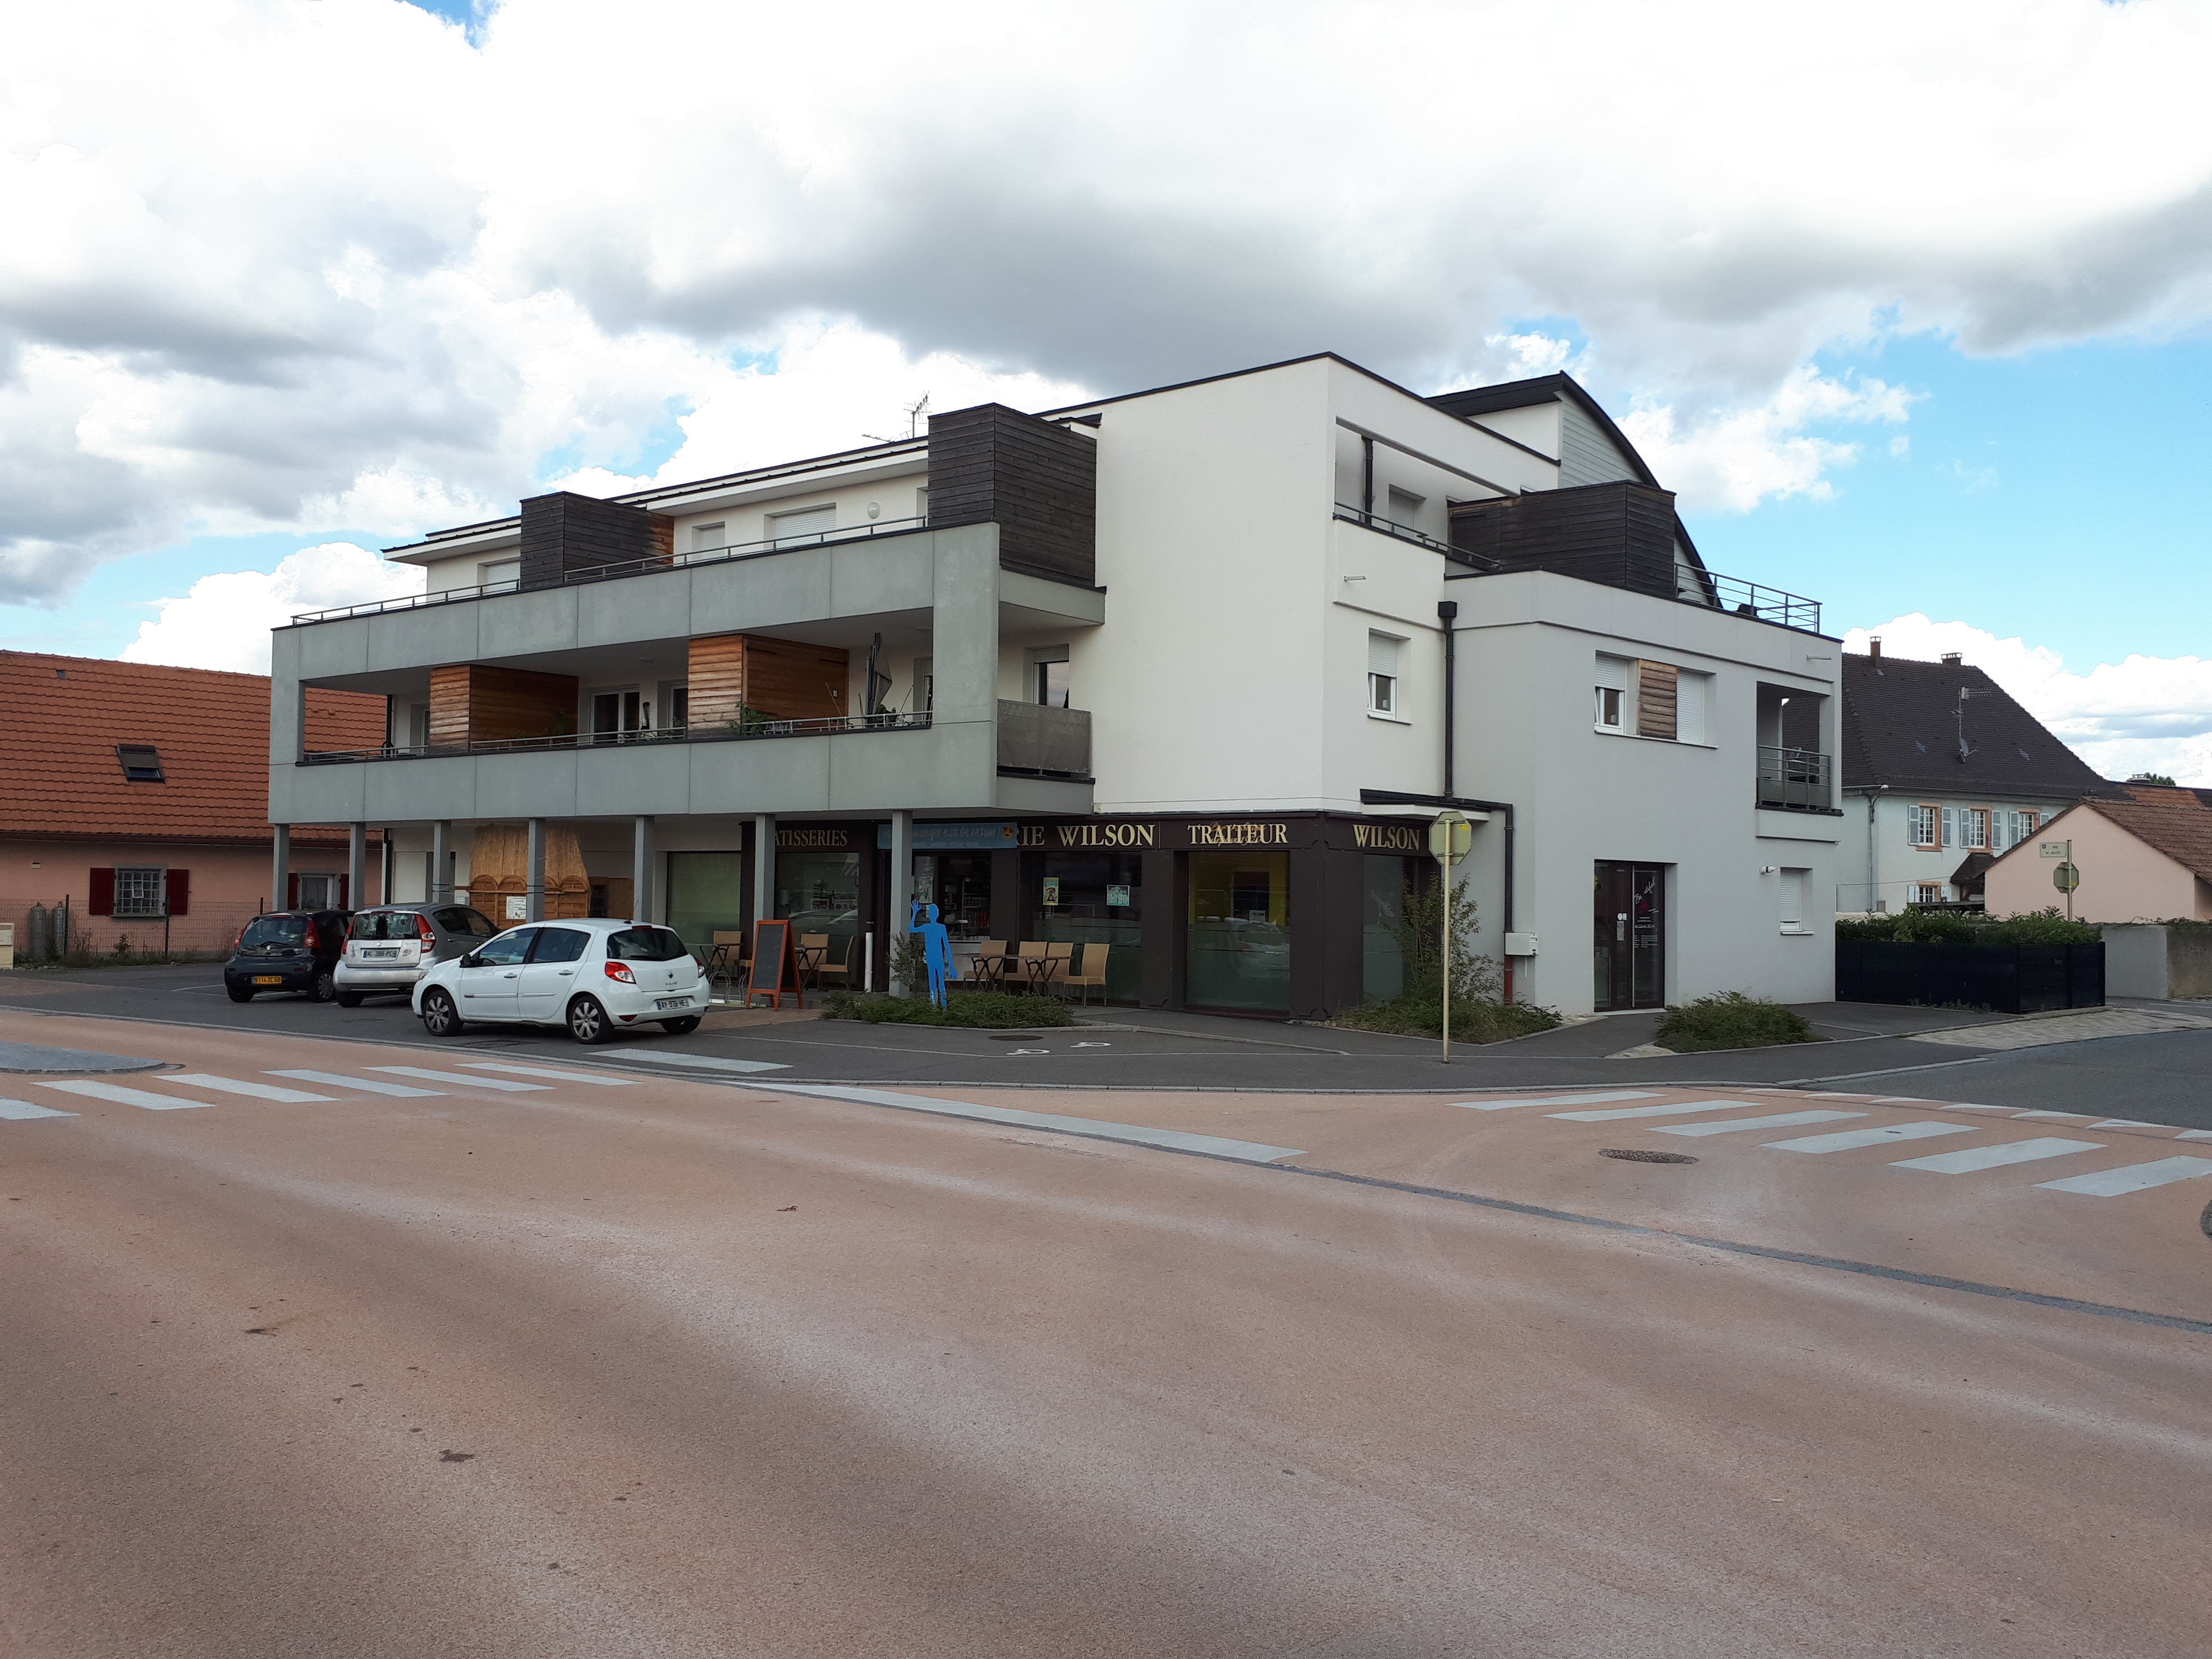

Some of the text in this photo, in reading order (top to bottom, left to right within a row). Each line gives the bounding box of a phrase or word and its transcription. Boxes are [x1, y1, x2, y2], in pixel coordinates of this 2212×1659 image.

[775, 830, 848, 847] ATISSERIES
[943, 829, 958, 837] est
[960, 826, 969, 837] de
[1056, 824, 1155, 846] WILSON
[1187, 824, 1289, 844] TRAITEUR
[1352, 824, 1420, 851] WILSON
